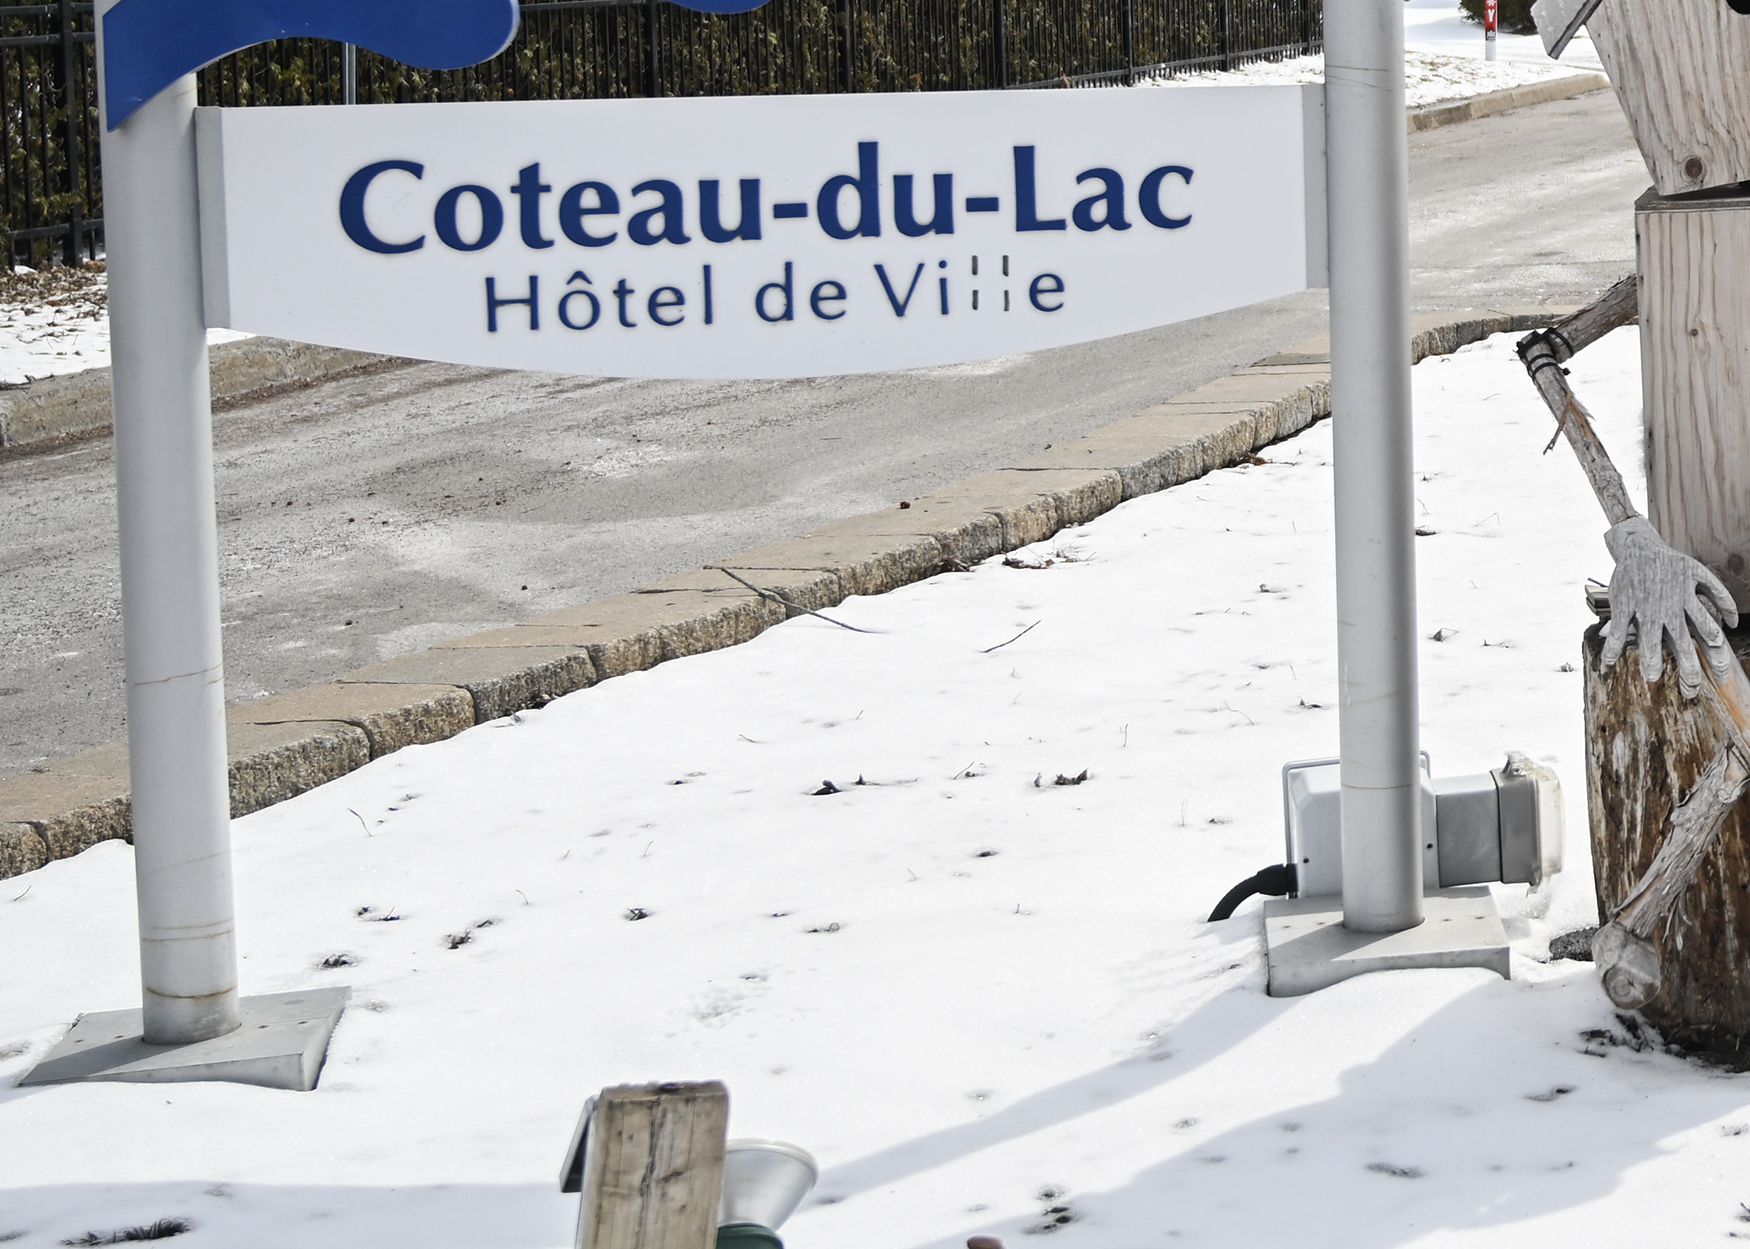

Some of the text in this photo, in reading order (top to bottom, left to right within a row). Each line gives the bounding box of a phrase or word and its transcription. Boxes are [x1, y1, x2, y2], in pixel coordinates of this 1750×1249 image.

[338, 141, 1195, 256] Coteau-du-Lac
[484, 253, 1066, 334] Hôtel de Ville
